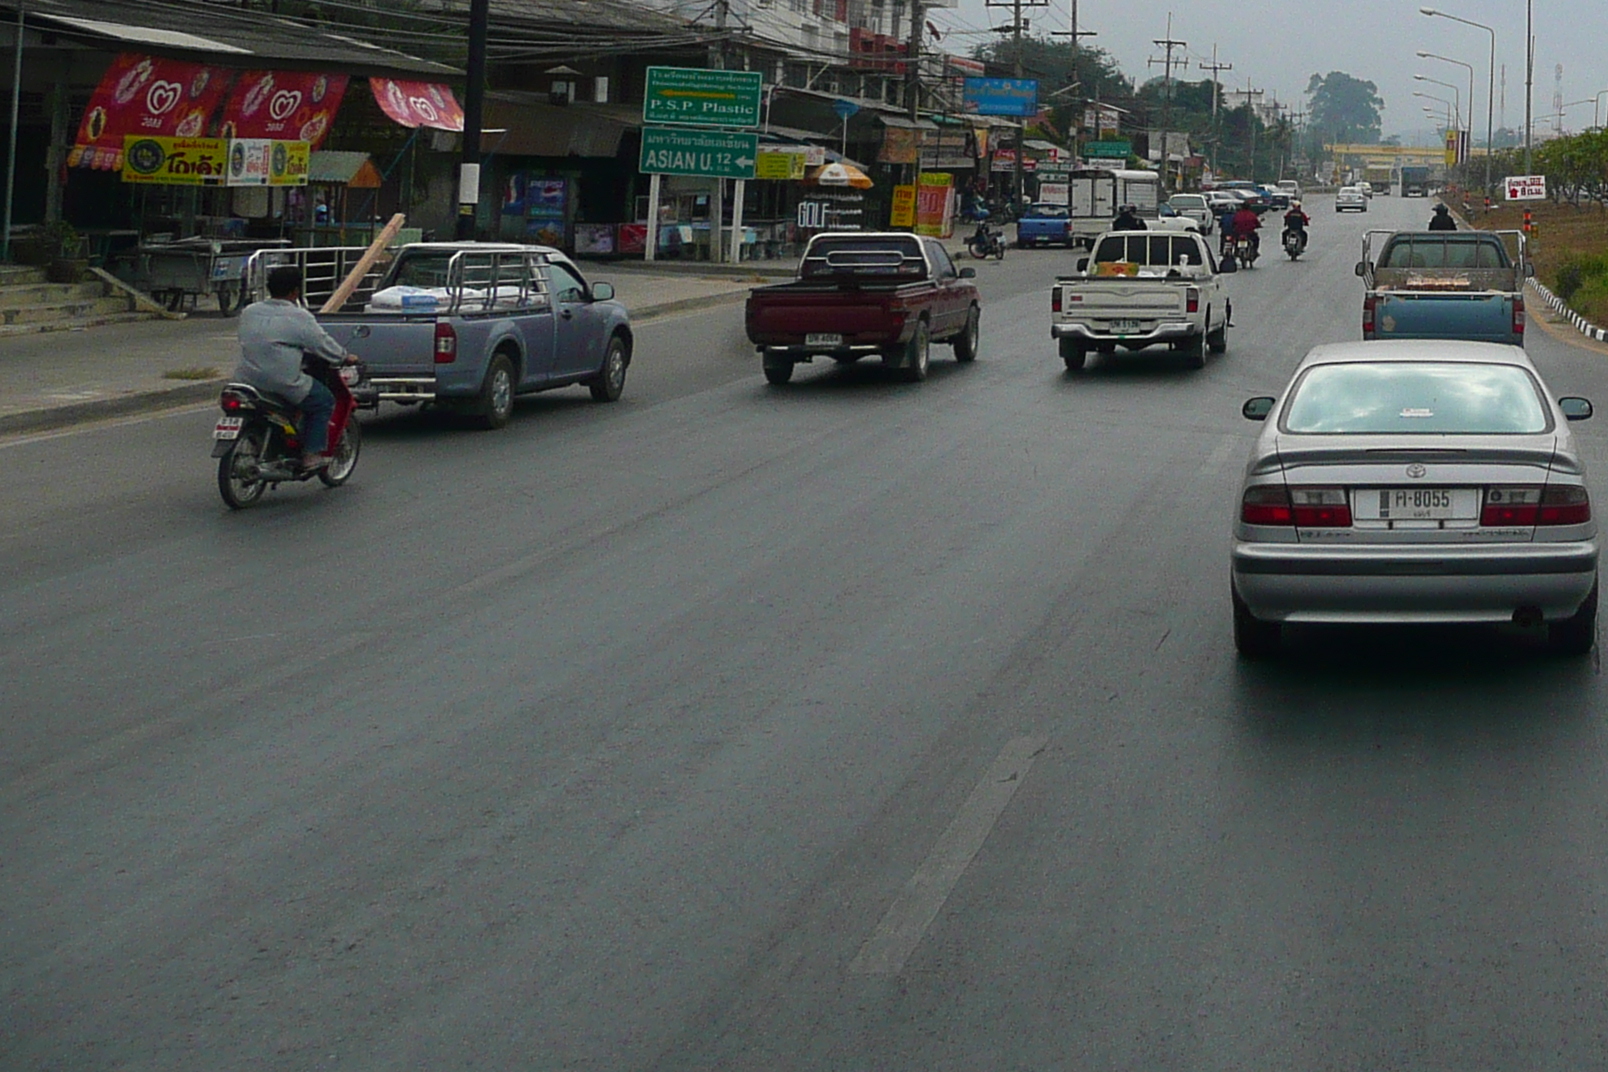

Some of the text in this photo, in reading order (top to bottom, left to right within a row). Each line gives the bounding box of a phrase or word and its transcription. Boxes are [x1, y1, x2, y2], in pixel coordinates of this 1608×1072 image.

[702, 102, 754, 115] Plastic
[645, 149, 696, 170] ASIAN
[716, 153, 732, 164] 12
[797, 201, 831, 228] GOLF
